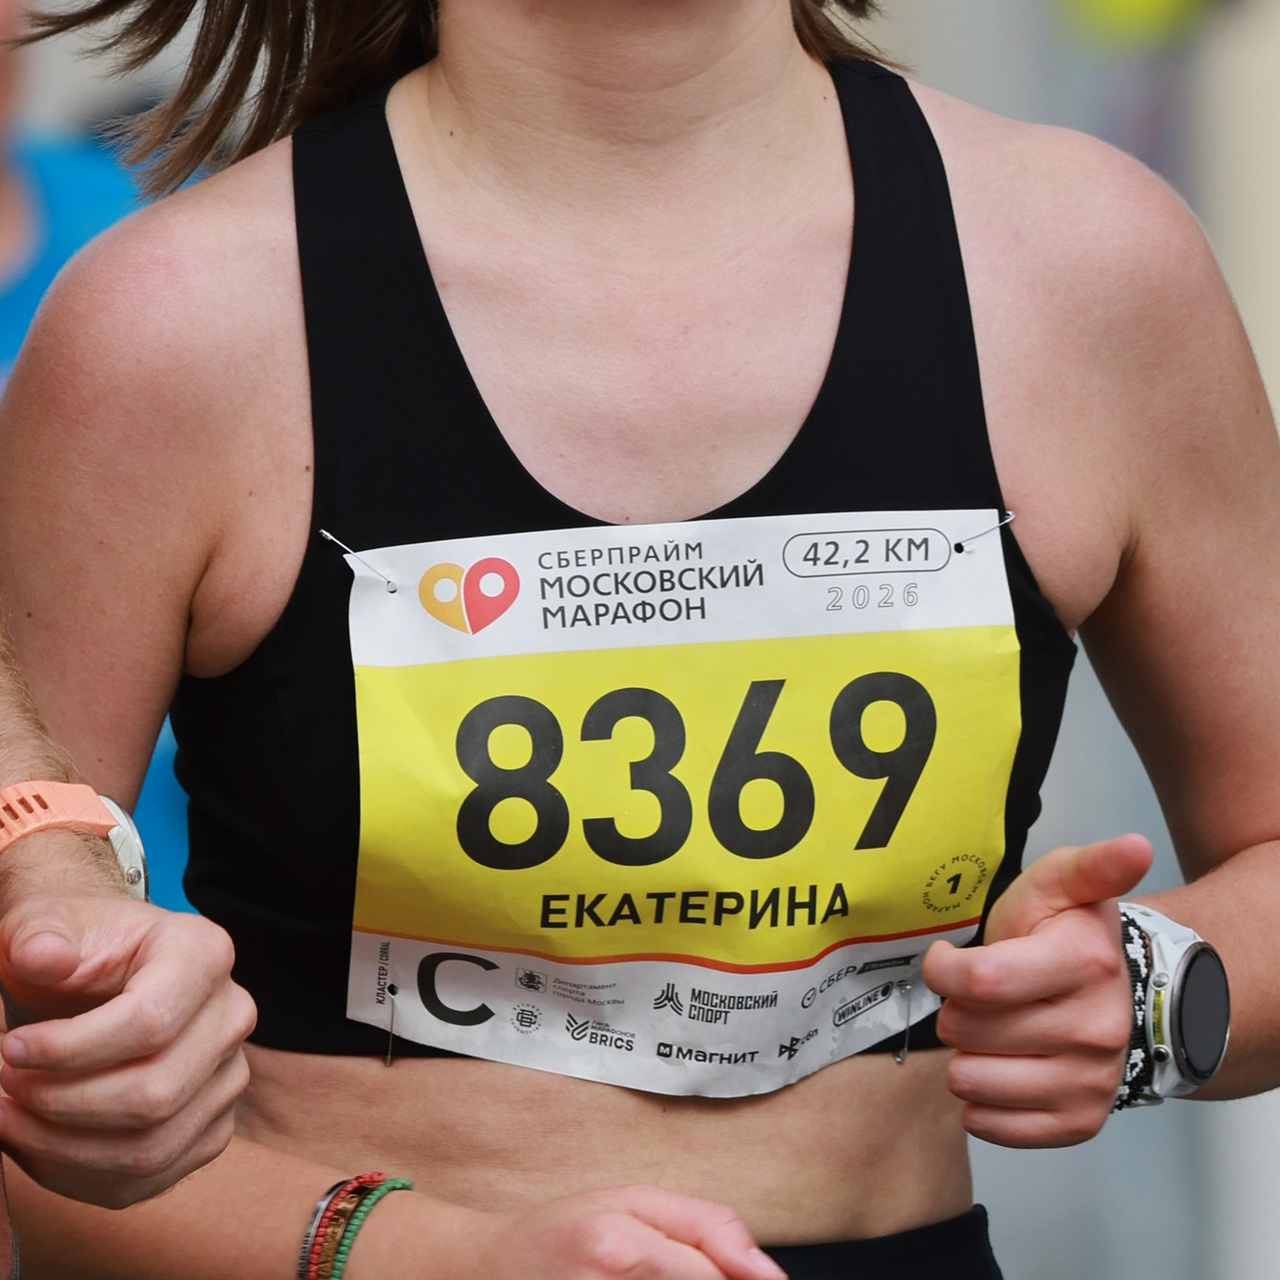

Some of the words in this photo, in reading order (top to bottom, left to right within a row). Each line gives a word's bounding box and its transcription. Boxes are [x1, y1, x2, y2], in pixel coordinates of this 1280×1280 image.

[538, 539, 704, 570] СБЕРПРАЙМ
[802, 539, 870, 569] 42,2
[884, 537, 930, 562] КМ
[540, 559, 765, 600] МОСКОВСКИЙ
[826, 582, 918, 611] 2026
[542, 596, 706, 629] МАРАФОН
[455, 672, 937, 870] 8369
[946, 872, 962, 895] 1
[539, 883, 850, 930] ЕКАТЕРИНА
[375, 966, 388, 1005] КЛАСТЕР
[416, 952, 500, 1027] C
[552, 978, 617, 990] Департамент
[820, 965, 857, 994] СБЕР
[587, 998, 625, 1007] Москвы
[690, 988, 778, 1010] МОСКОВСКИЙ
[838, 989, 880, 1022] WINLINE
[688, 1005, 731, 1025] СПОРТ
[588, 1031, 635, 1052] BRICS
[800, 1027, 819, 1045] сбп
[676, 1046, 760, 1065] магнит
